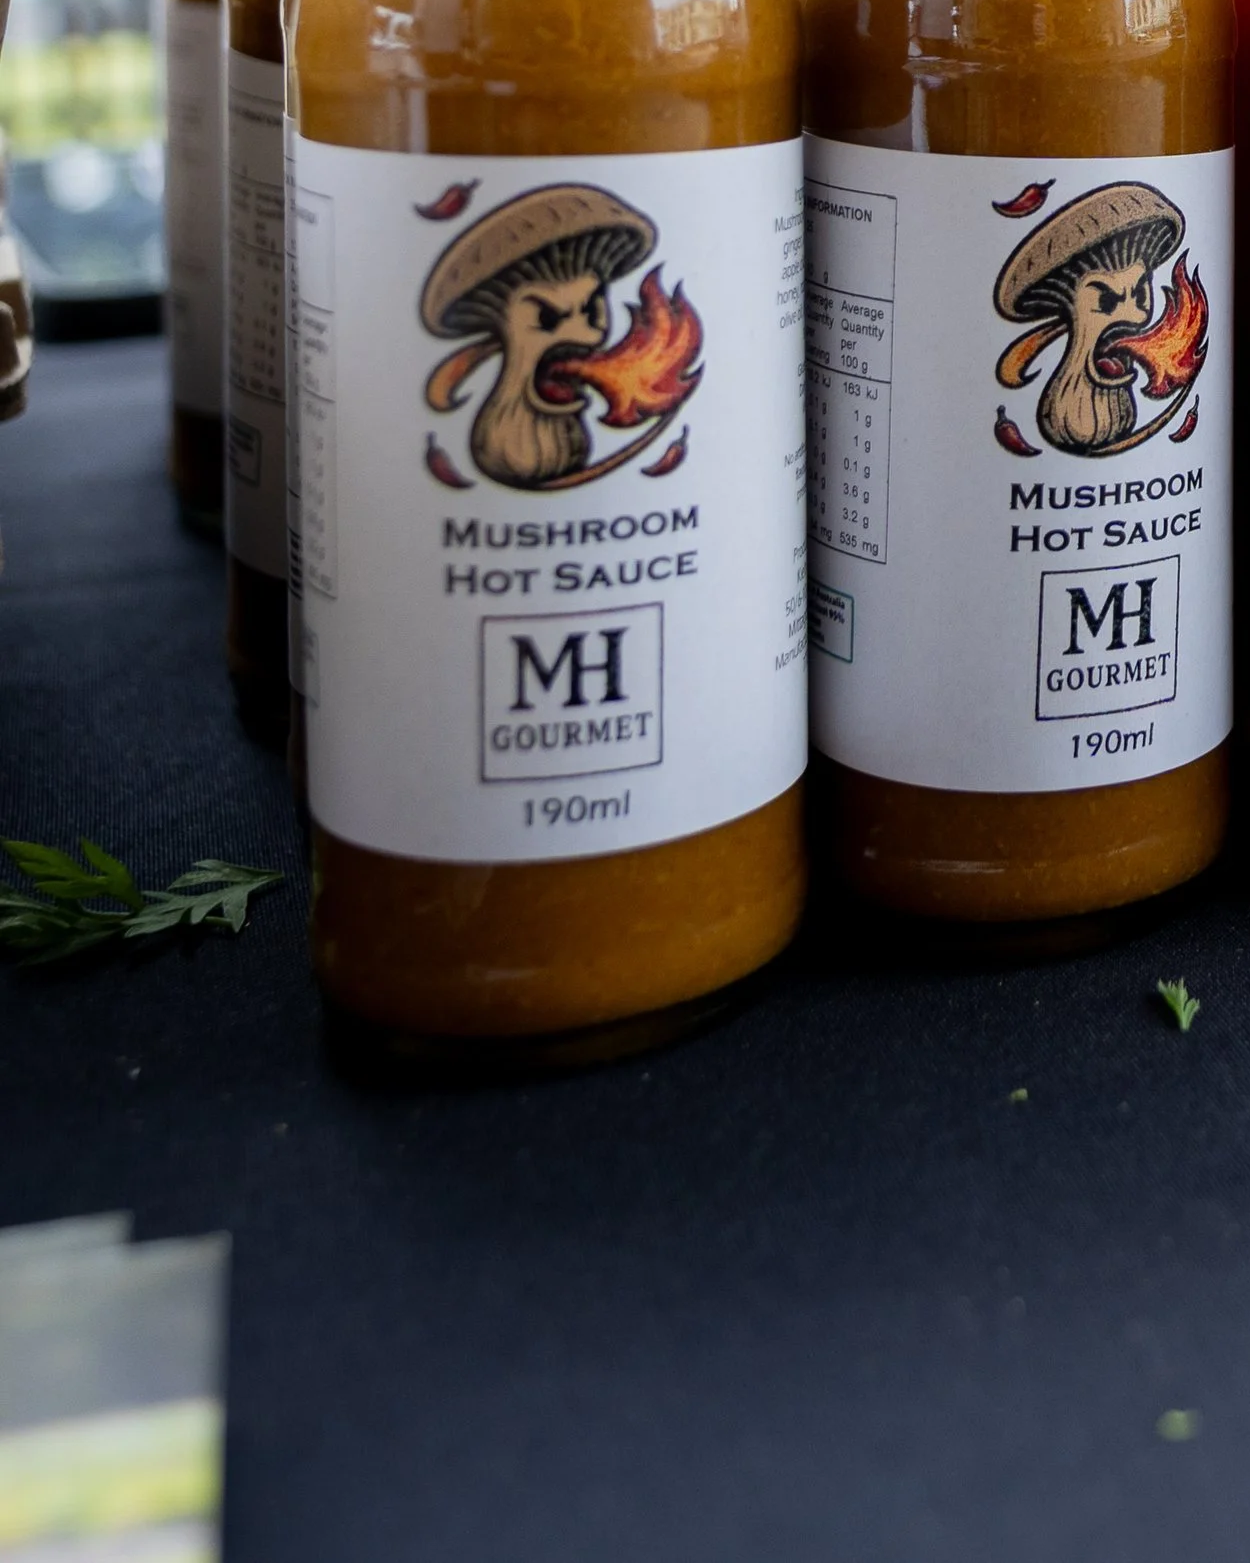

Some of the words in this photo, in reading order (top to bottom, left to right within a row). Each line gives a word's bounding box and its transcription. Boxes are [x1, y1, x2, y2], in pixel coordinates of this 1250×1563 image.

[841, 300, 884, 322] Average
[841, 318, 885, 341] Quantity
[841, 339, 857, 351] per
[841, 354, 858, 370] 100
[862, 361, 868, 375] g
[866, 386, 878, 401] kJ
[865, 415, 872, 428] g
[864, 440, 871, 454] g
[843, 458, 858, 473] 0.1
[864, 466, 871, 479] g
[843, 482, 858, 498] 3.6
[863, 491, 870, 504] g
[842, 507, 858, 523] 3.2
[862, 517, 869, 530] g
[840, 531, 857, 548] 535
[862, 541, 879, 556] mg
[1062, 576, 1158, 656] MH
[507, 626, 630, 712] MH
[1046, 652, 1171, 692] GOURMET
[491, 711, 654, 753] GOURMET
[1071, 722, 1155, 759] 190ml
[523, 790, 632, 828] 190ml
